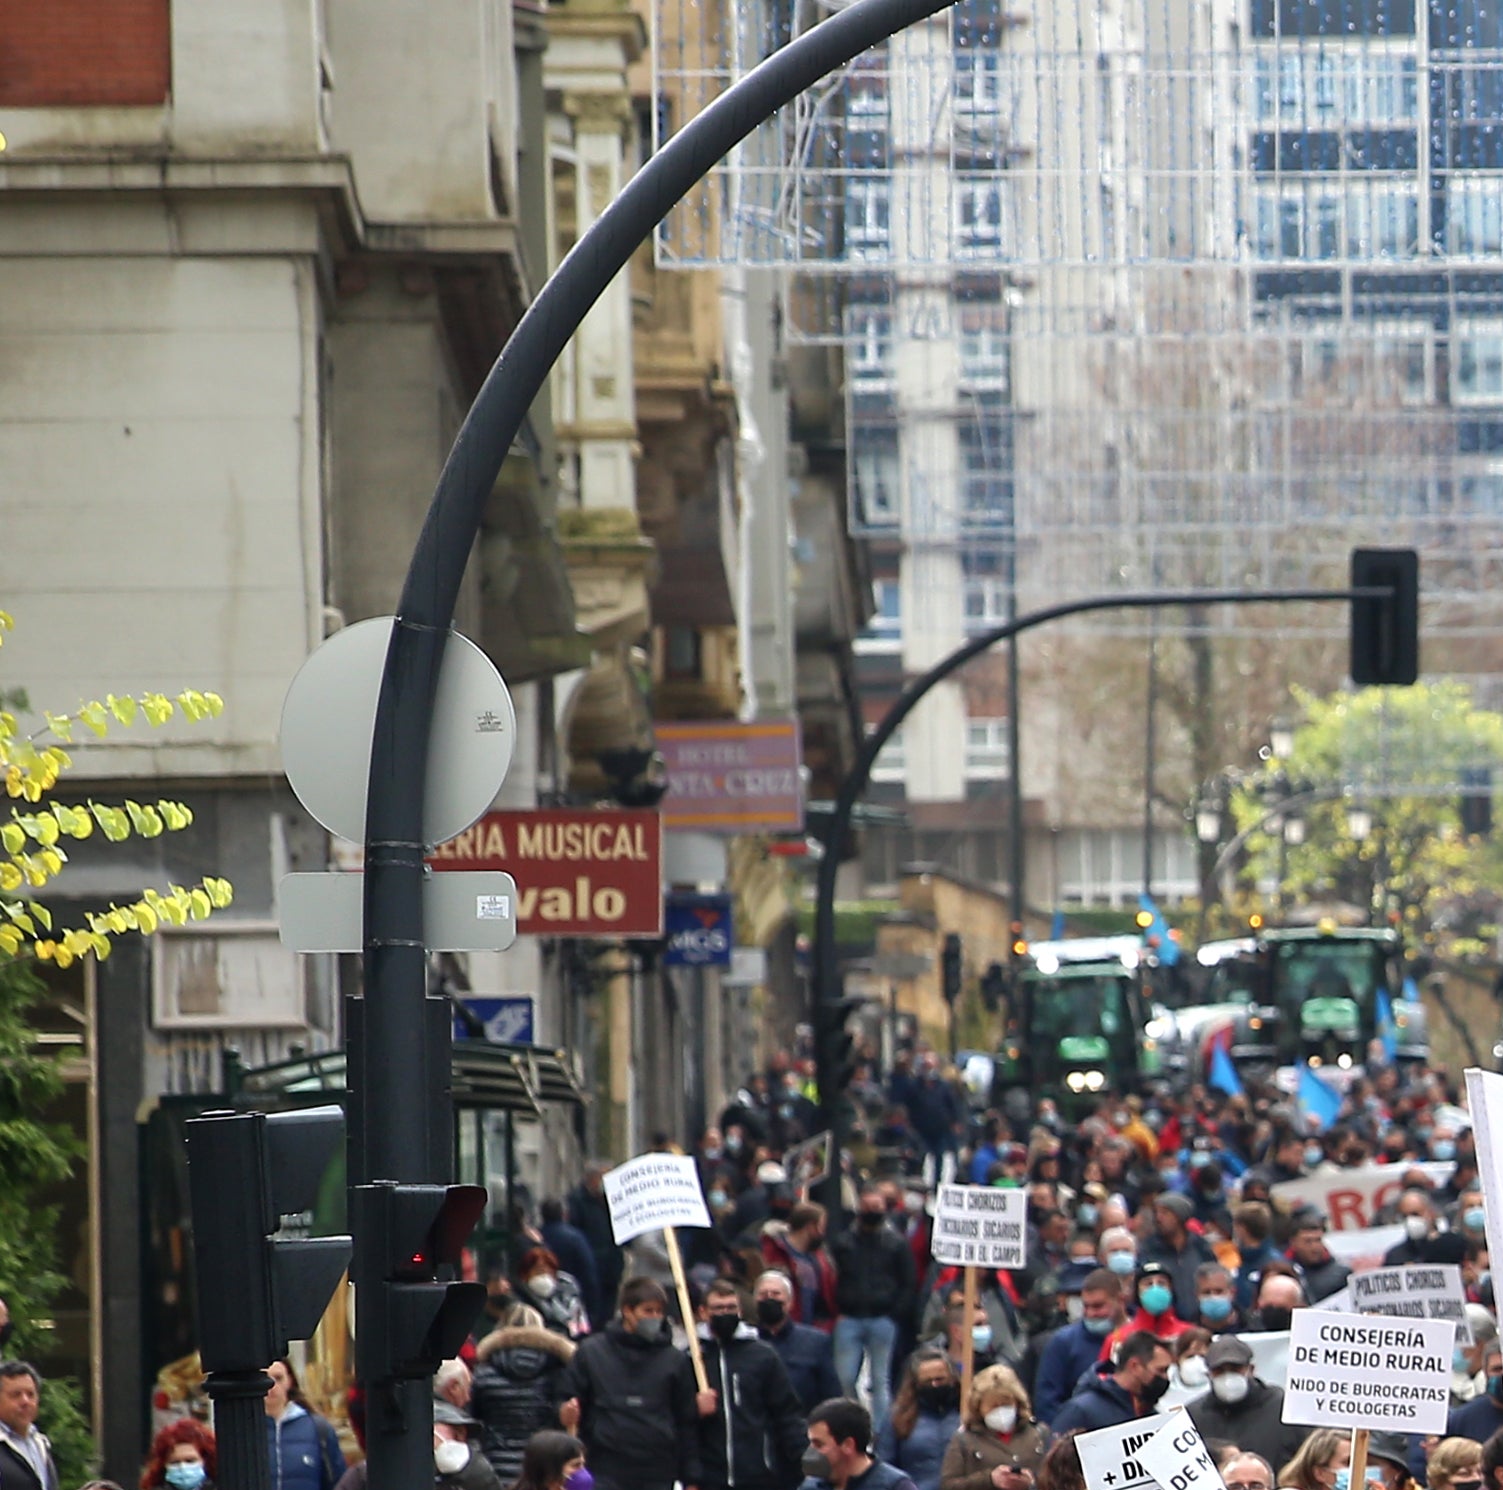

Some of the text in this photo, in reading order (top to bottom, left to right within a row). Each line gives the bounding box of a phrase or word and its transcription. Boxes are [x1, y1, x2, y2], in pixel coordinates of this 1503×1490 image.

[724, 767, 794, 796] CRUZ
[517, 822, 648, 861] MUSICAL
[1355, 1273, 1400, 1296] POLITICOS
[1320, 1325, 1426, 1348] CONSEJERÍA
[1295, 1346, 1446, 1373] DE MEDIO RURAL
[1290, 1377, 1446, 1402] NIDO DE BUROCRATAS
[1316, 1398, 1417, 1418] Y ECOLOGETAS
